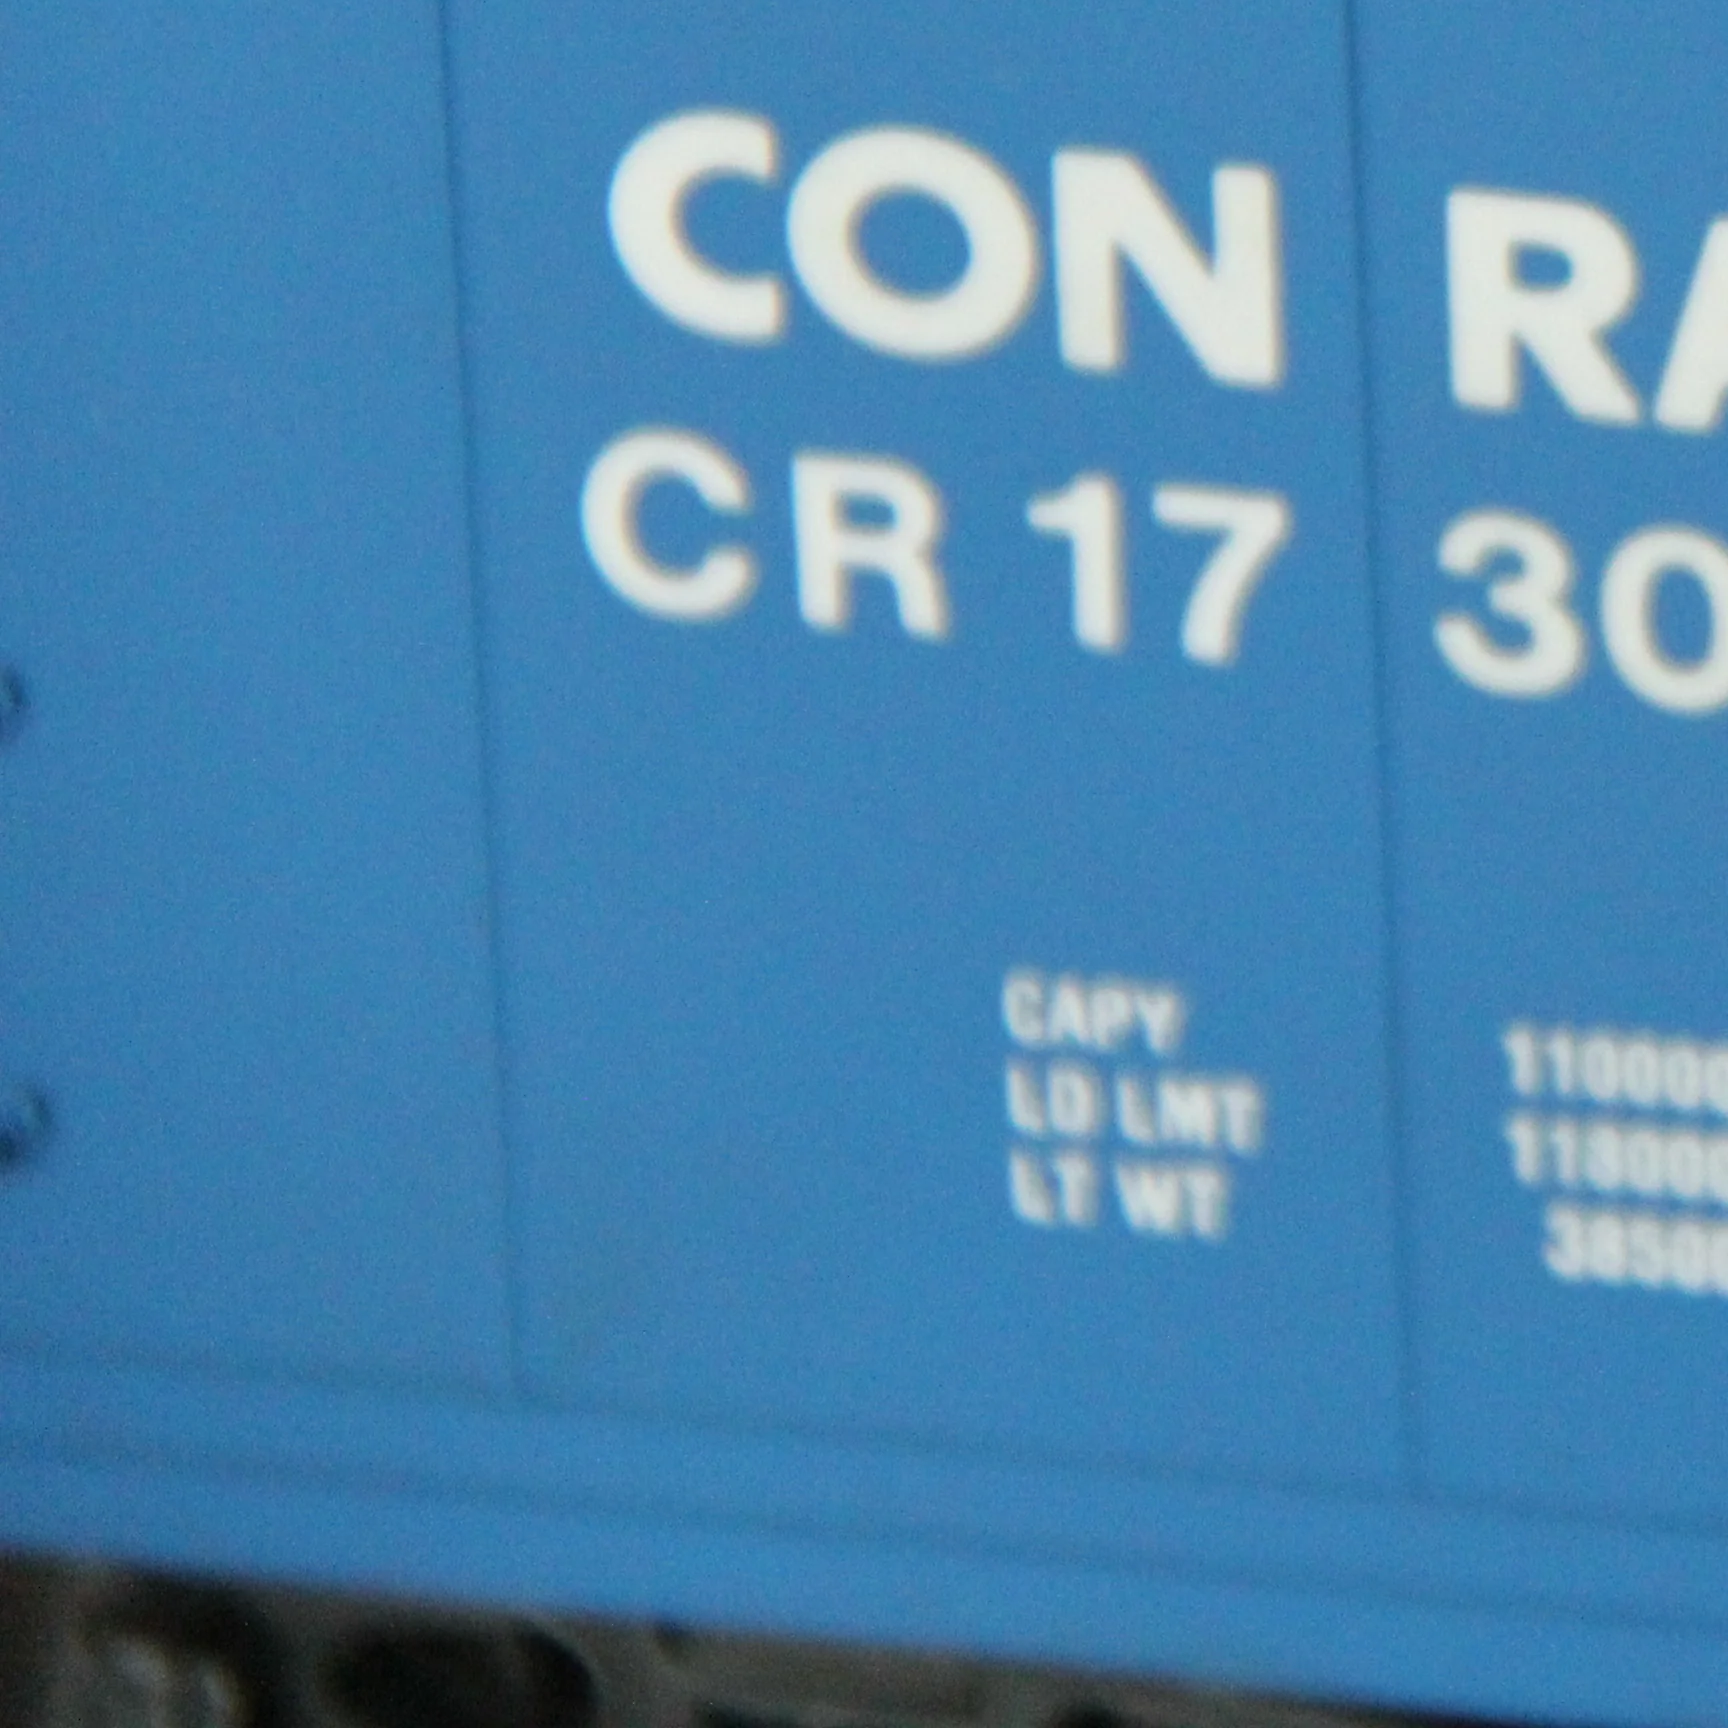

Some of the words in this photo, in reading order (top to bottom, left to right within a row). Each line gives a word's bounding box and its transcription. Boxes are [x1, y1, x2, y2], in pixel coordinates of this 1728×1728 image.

[609, 109, 1285, 389] CON
[582, 428, 949, 638] CR
[1002, 973, 1184, 1052] CAPY
[1006, 1062, 1105, 1140] LD
[1118, 1078, 1261, 1150] LMT
[1009, 1145, 1099, 1225] LT
[1116, 1162, 1228, 1236] WT
